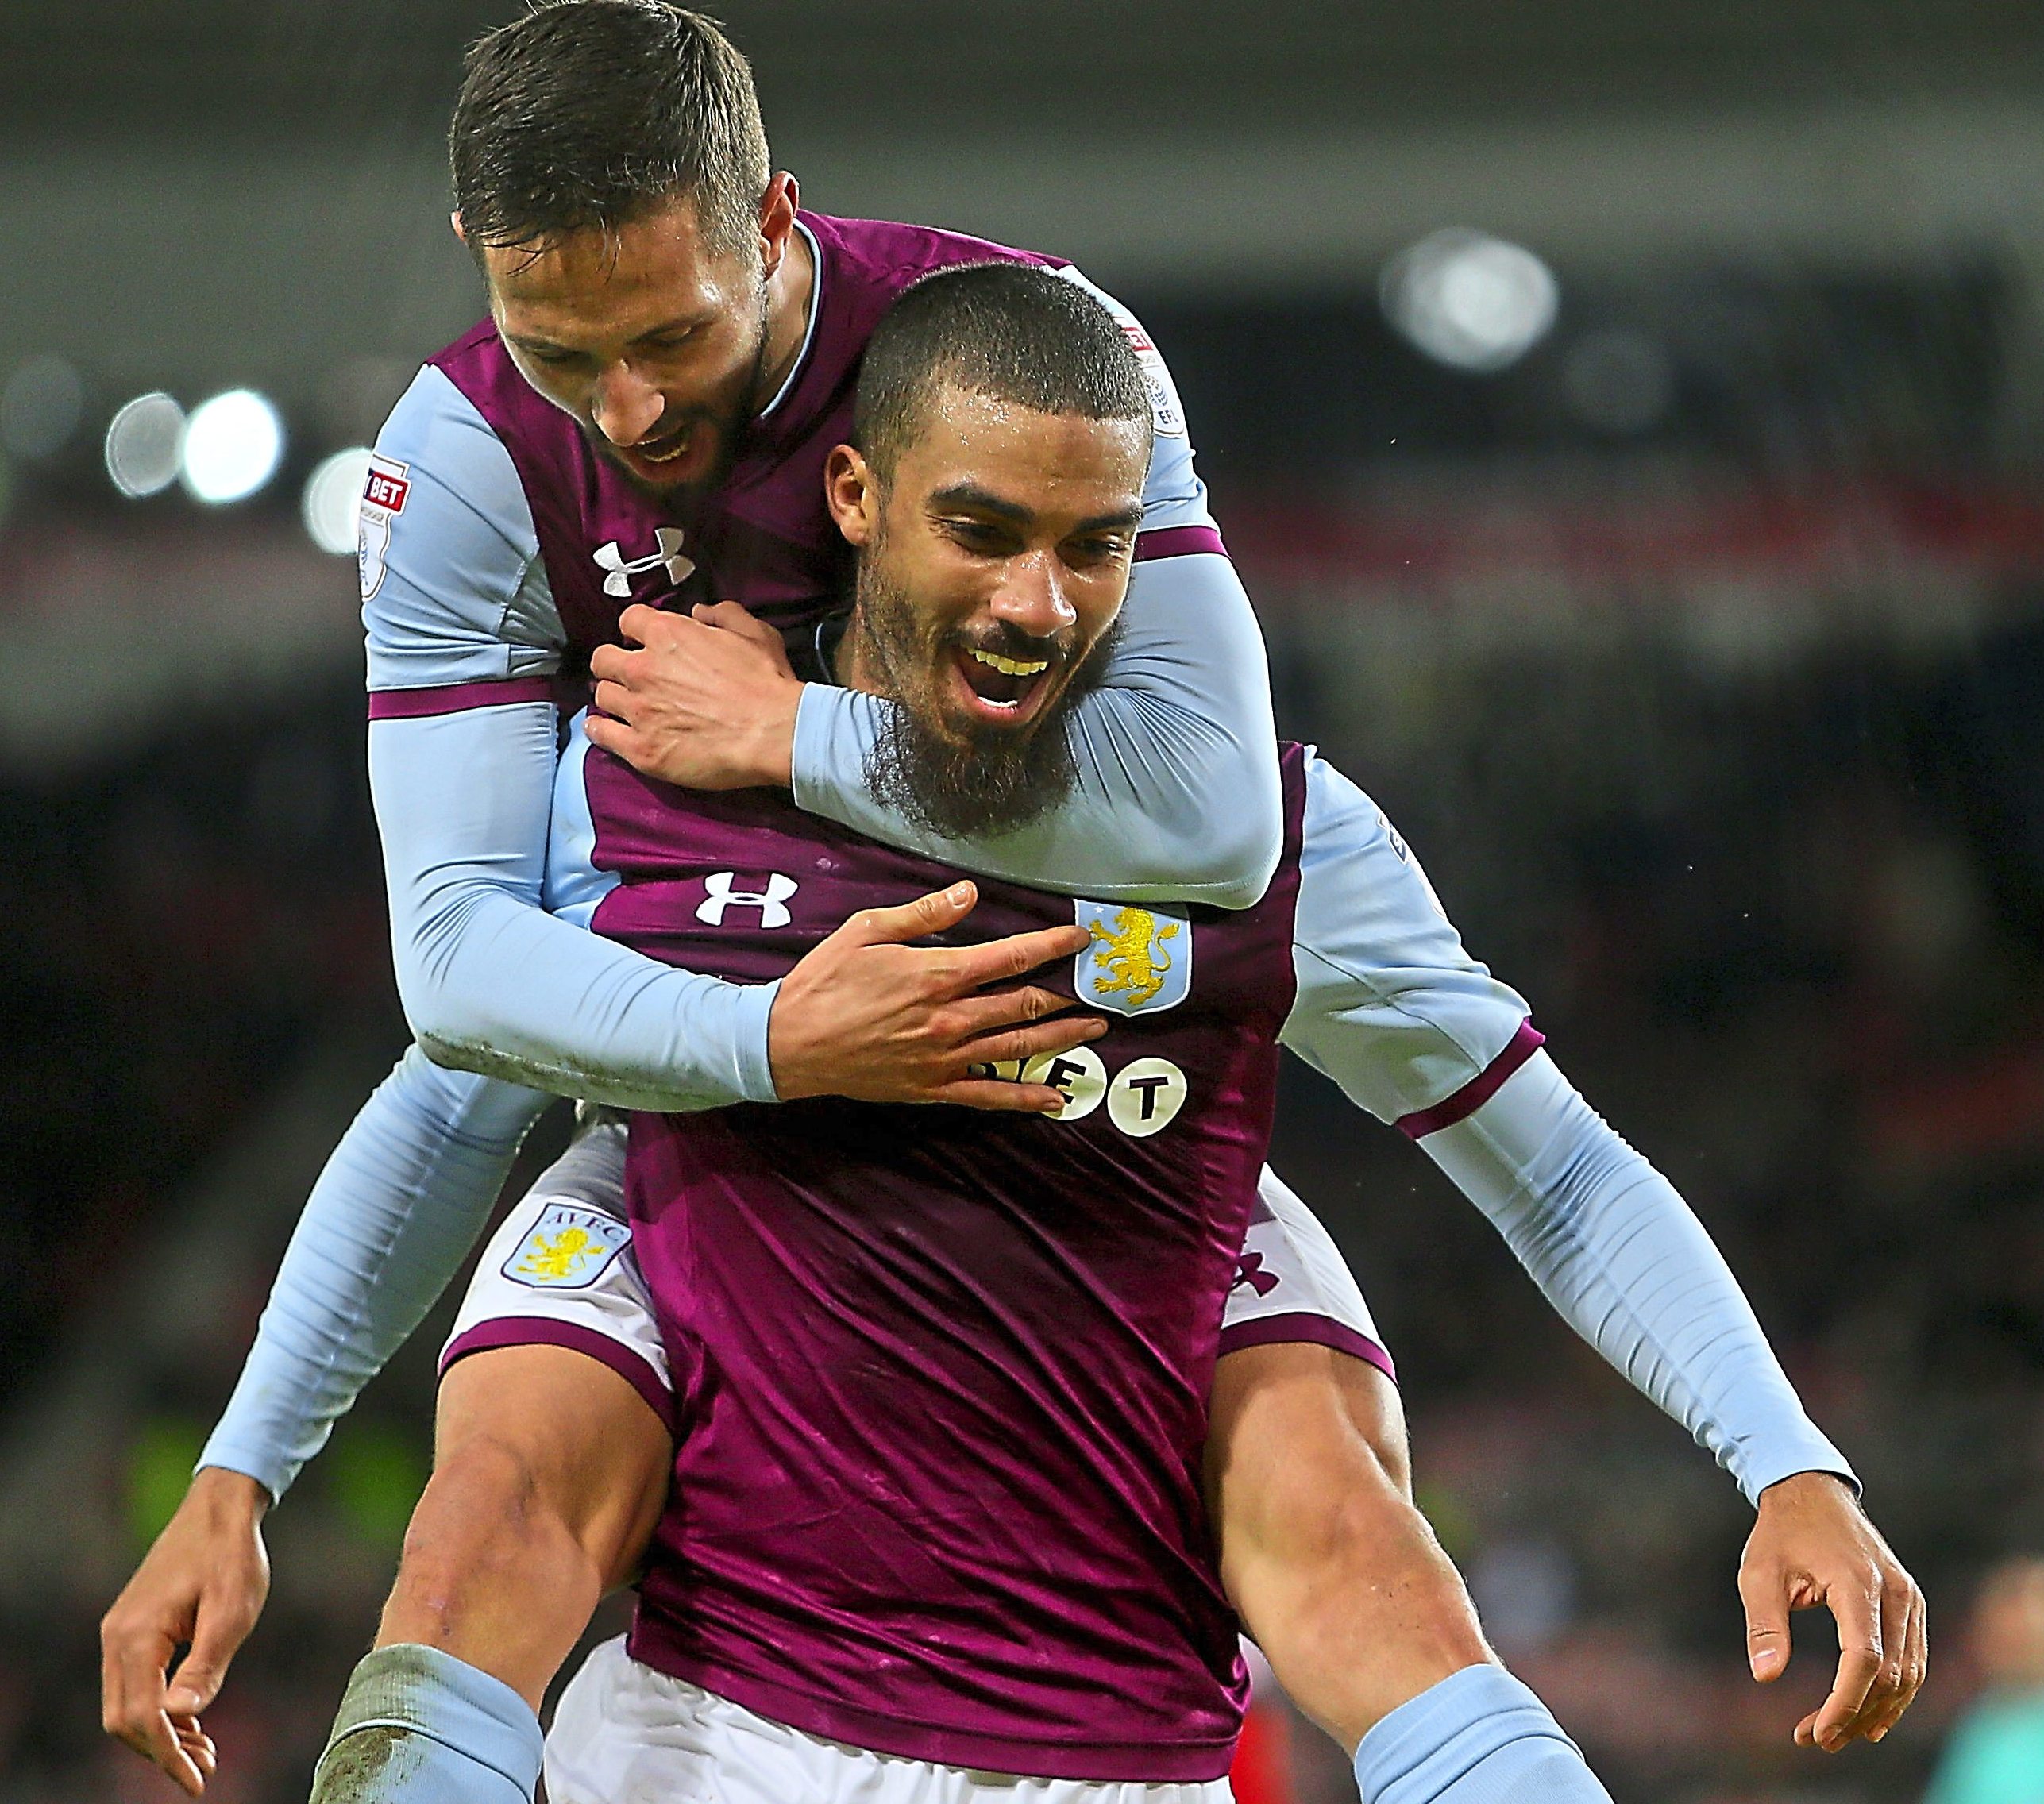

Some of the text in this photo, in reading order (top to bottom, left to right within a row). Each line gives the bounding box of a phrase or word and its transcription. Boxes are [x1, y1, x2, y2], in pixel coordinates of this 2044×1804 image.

[369, 476, 403, 505] BET
[966, 1057, 1169, 1121] ET
[546, 1211, 625, 1243] AVFC
